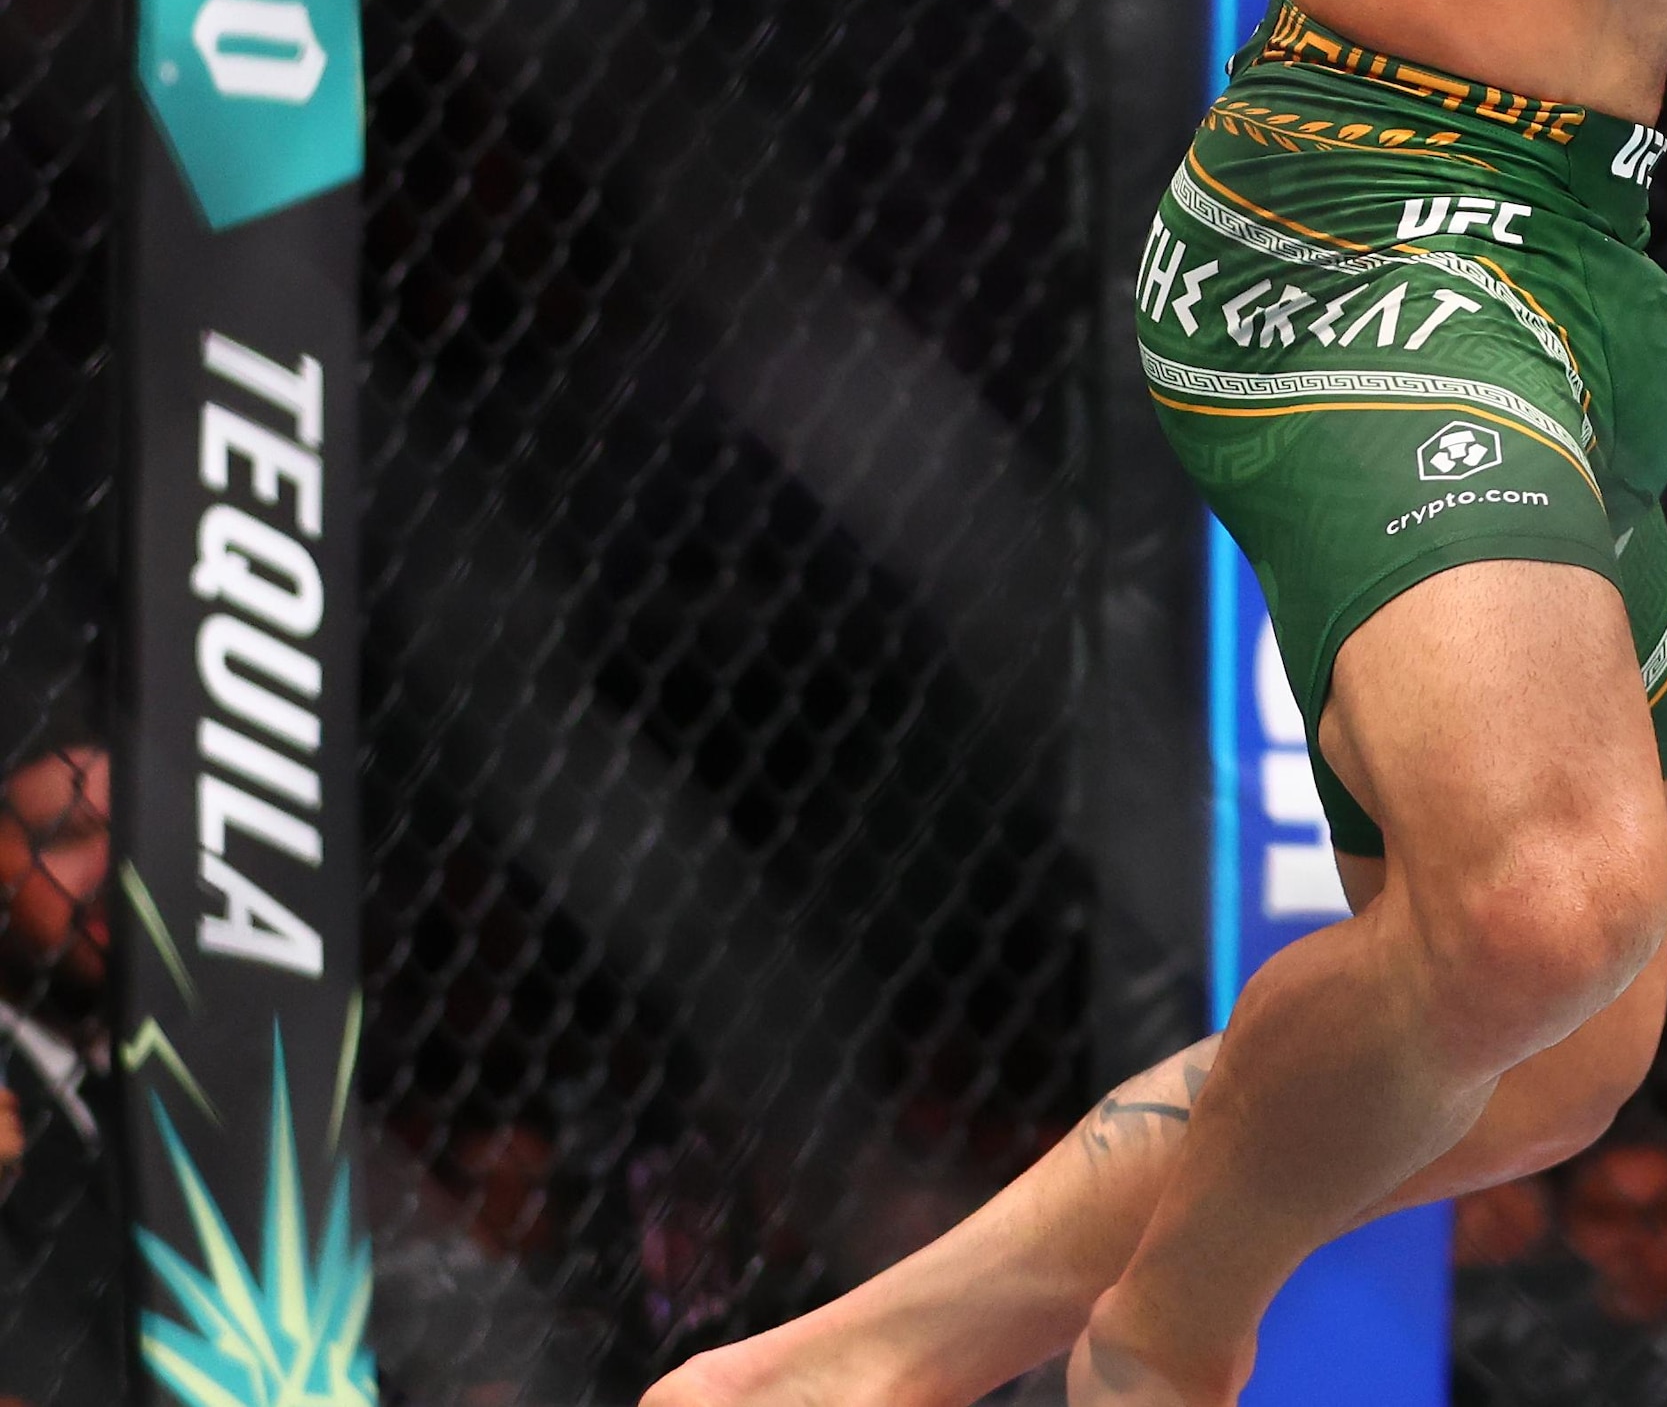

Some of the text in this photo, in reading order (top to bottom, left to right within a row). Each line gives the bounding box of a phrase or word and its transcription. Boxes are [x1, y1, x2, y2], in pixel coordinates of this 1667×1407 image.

[1397, 196, 1533, 245] UFC
[1135, 211, 1482, 351] THE GREAT
[1386, 489, 1549, 536] crypto.com
[191, 328, 324, 980] TEQUILA
